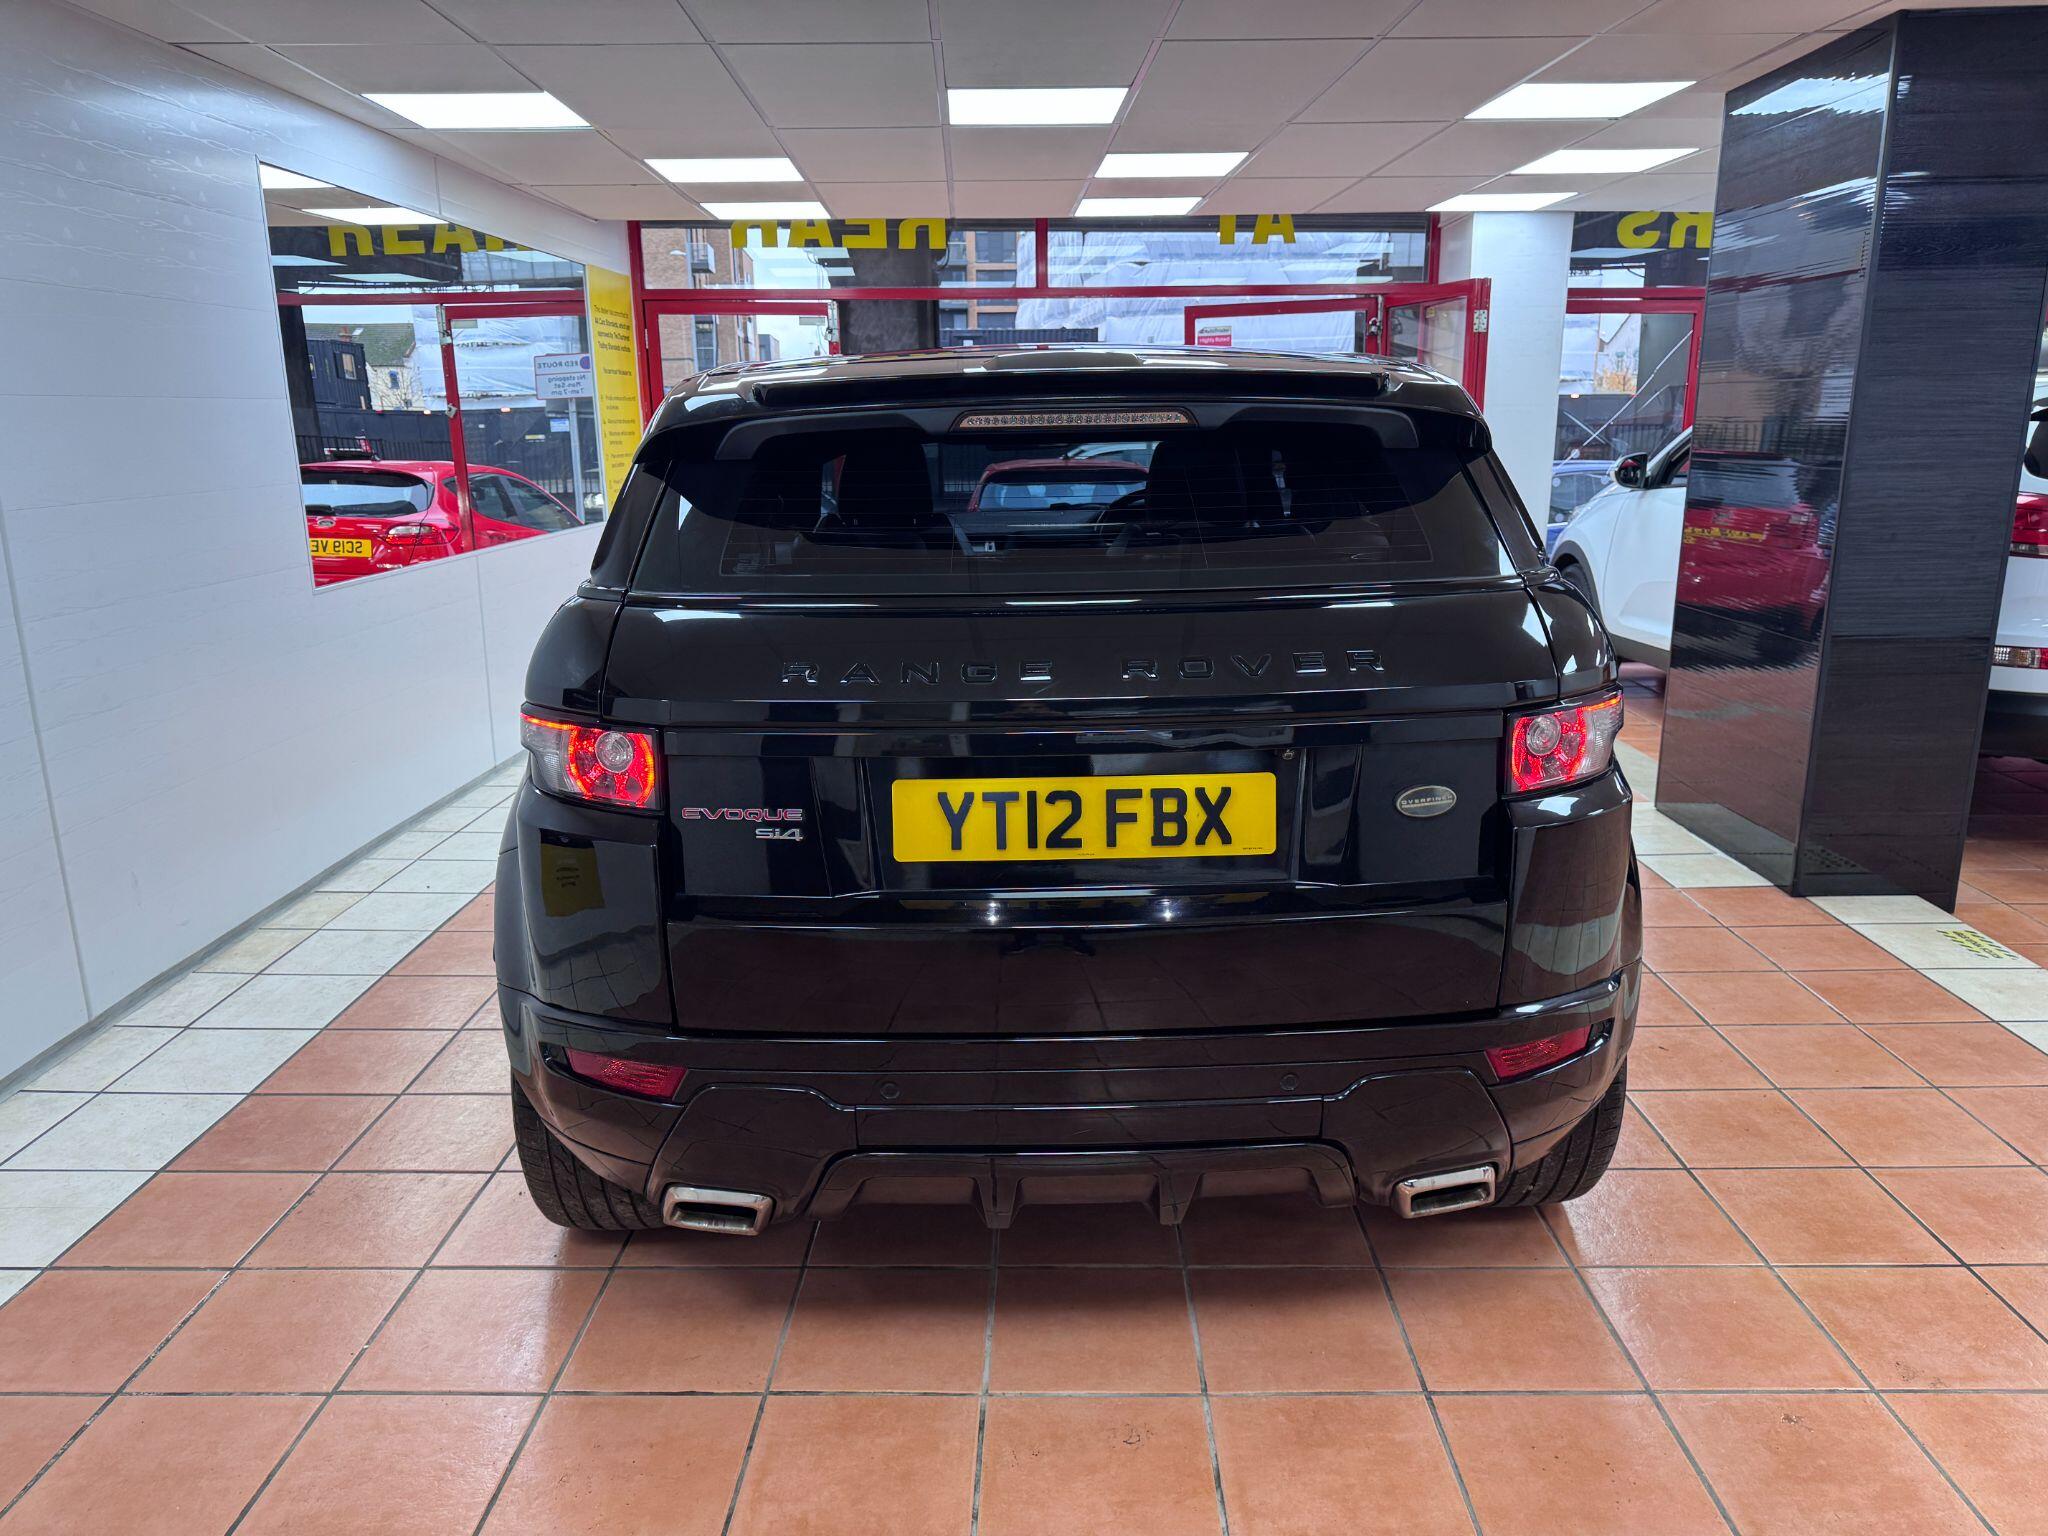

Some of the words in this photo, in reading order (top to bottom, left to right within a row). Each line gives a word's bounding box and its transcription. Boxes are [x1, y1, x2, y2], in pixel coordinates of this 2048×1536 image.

[779, 660, 1055, 686] RANGE
[1120, 649, 1385, 681] ROVER
[1400, 795, 1454, 806] OVERFINCH
[681, 807, 804, 823] EVOQUE
[937, 790, 1083, 851] YT12
[1105, 786, 1232, 849] FBX
[755, 828, 804, 842] Si4
